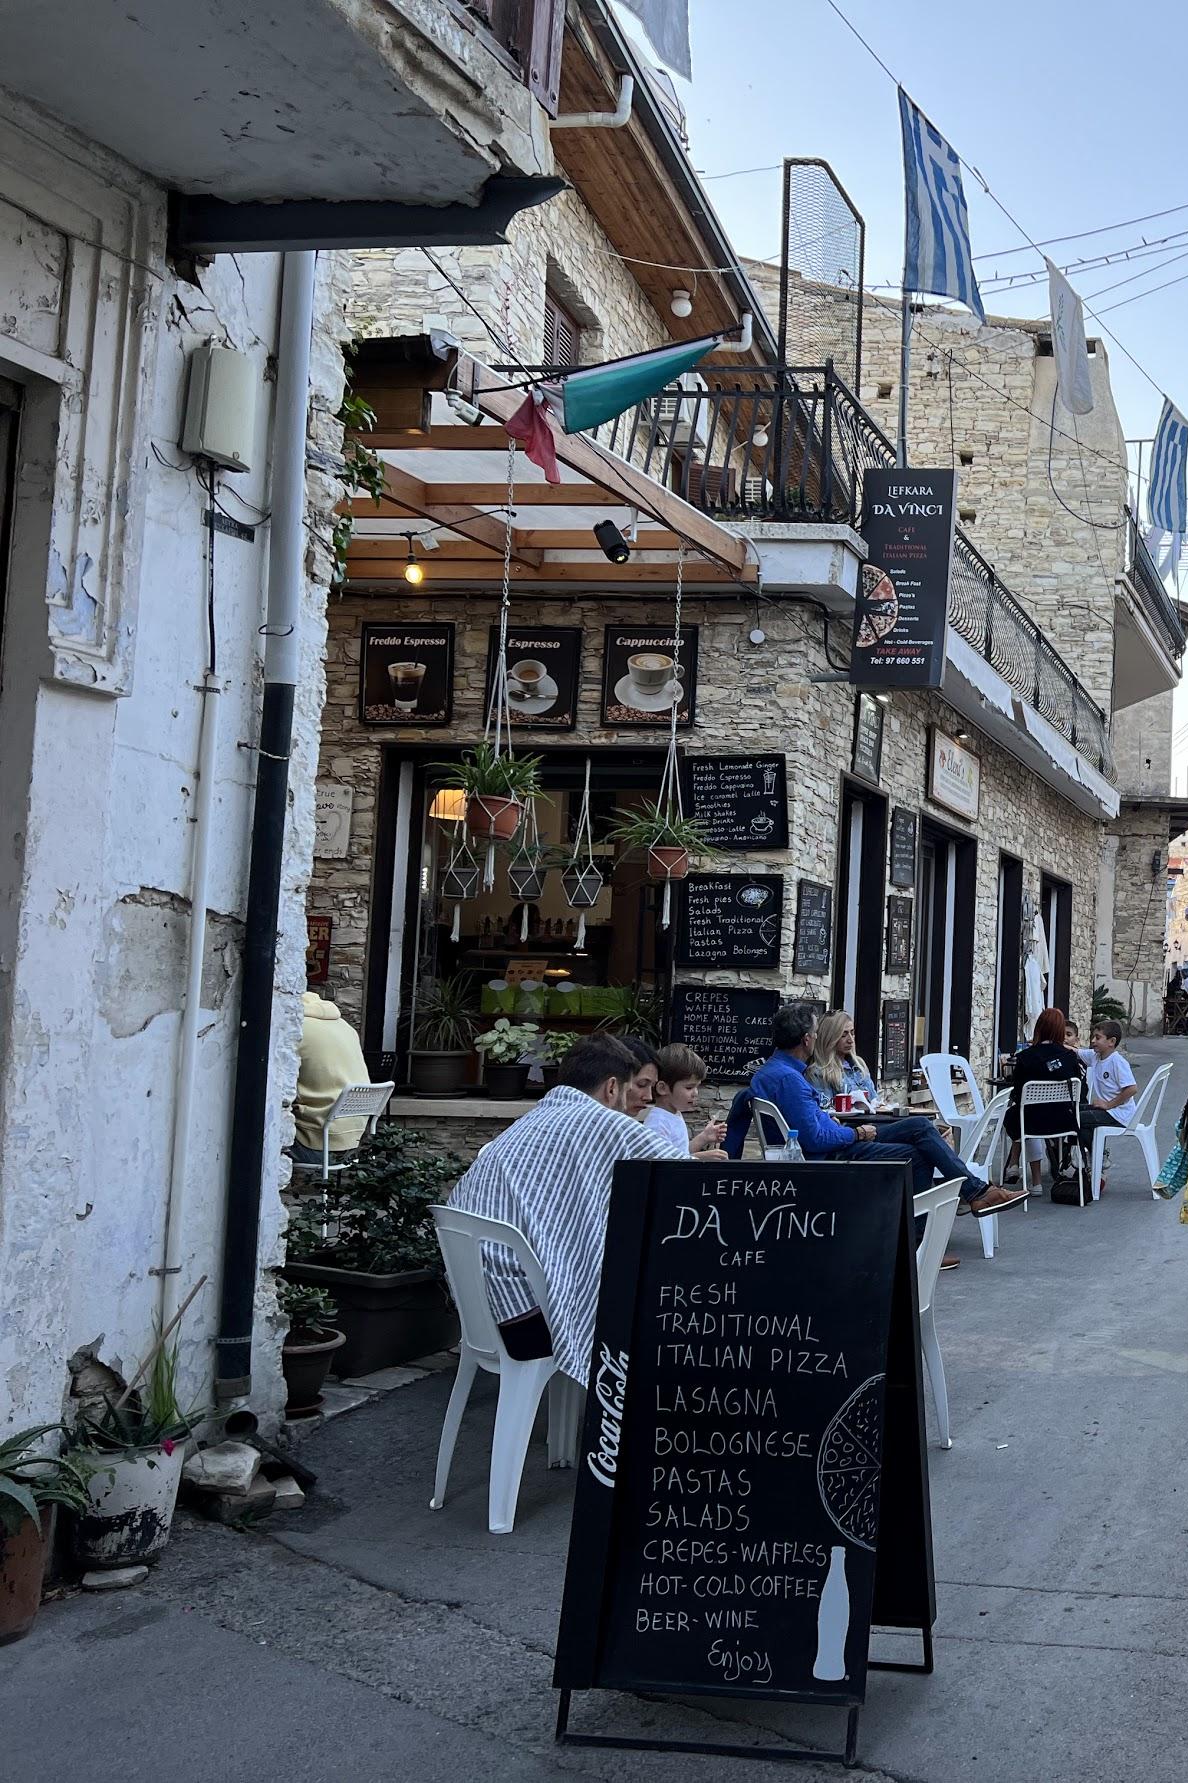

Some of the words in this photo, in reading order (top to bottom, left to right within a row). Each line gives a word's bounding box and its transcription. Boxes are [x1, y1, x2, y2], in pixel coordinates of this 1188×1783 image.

[888, 486, 933, 498] LEFKARA
[872, 504, 896, 517] DA
[899, 502, 943, 516] VINCI
[370, 636, 401, 646] Freddo
[404, 637, 446, 647] Espresso
[508, 638, 561, 649] Espresso
[616, 637, 685, 647] Cappuccino
[870, 657, 883, 665] Tel:
[885, 657, 895, 665] 97
[896, 657, 910, 665] 660
[911, 657, 925, 665] 551
[692, 763, 714, 771] Fresh
[719, 762, 753, 771] Lemonade
[756, 761, 779, 771] Ginger
[719, 773, 752, 782] Espresso
[694, 793, 705, 801] Ice
[710, 791, 738, 799] caramel
[695, 802, 731, 810] Smoothies
[688, 882, 732, 892] Breakfast
[689, 896, 709, 904] Fresh
[714, 896, 732, 907] pies
[689, 906, 721, 916] Salads
[716, 915, 764, 924] Traditional
[689, 927, 721, 937] Italian
[728, 925, 753, 935] Pizza
[690, 937, 723, 947] Pastas
[689, 949, 727, 960] Lazagna
[685, 992, 729, 1003] CREPES
[685, 1004, 731, 1013] WAFFLES
[683, 1014, 709, 1022] HOME
[712, 1015, 739, 1023] MADE
[745, 1017, 773, 1025] CAKES
[683, 1025, 712, 1033] FRESH
[718, 1026, 737, 1034] PIES
[683, 1035, 739, 1045] TRADITIONAL
[744, 1037, 773, 1046] SWEETS
[714, 1046, 759, 1054] LEMONADE
[702, 1055, 735, 1064] CREAM
[701, 1179, 797, 1198] LEFKARA
[661, 1205, 729, 1247] DA
[749, 1203, 836, 1242] VINCI
[719, 1250, 766, 1267] CAFE
[659, 1281, 737, 1307] FRESH
[655, 1312, 820, 1343] TRADITIONAL
[657, 1344, 752, 1369] ITALIAN
[771, 1348, 848, 1379] PIZZA
[656, 1385, 777, 1418] LASAGNA
[654, 1427, 813, 1458] BOLOGNESE
[653, 1466, 752, 1497] PASTAS
[646, 1501, 751, 1532] SALADS
[750, 1576, 820, 1600] COFFEE
[707, 1639, 773, 1683] Enjoy
